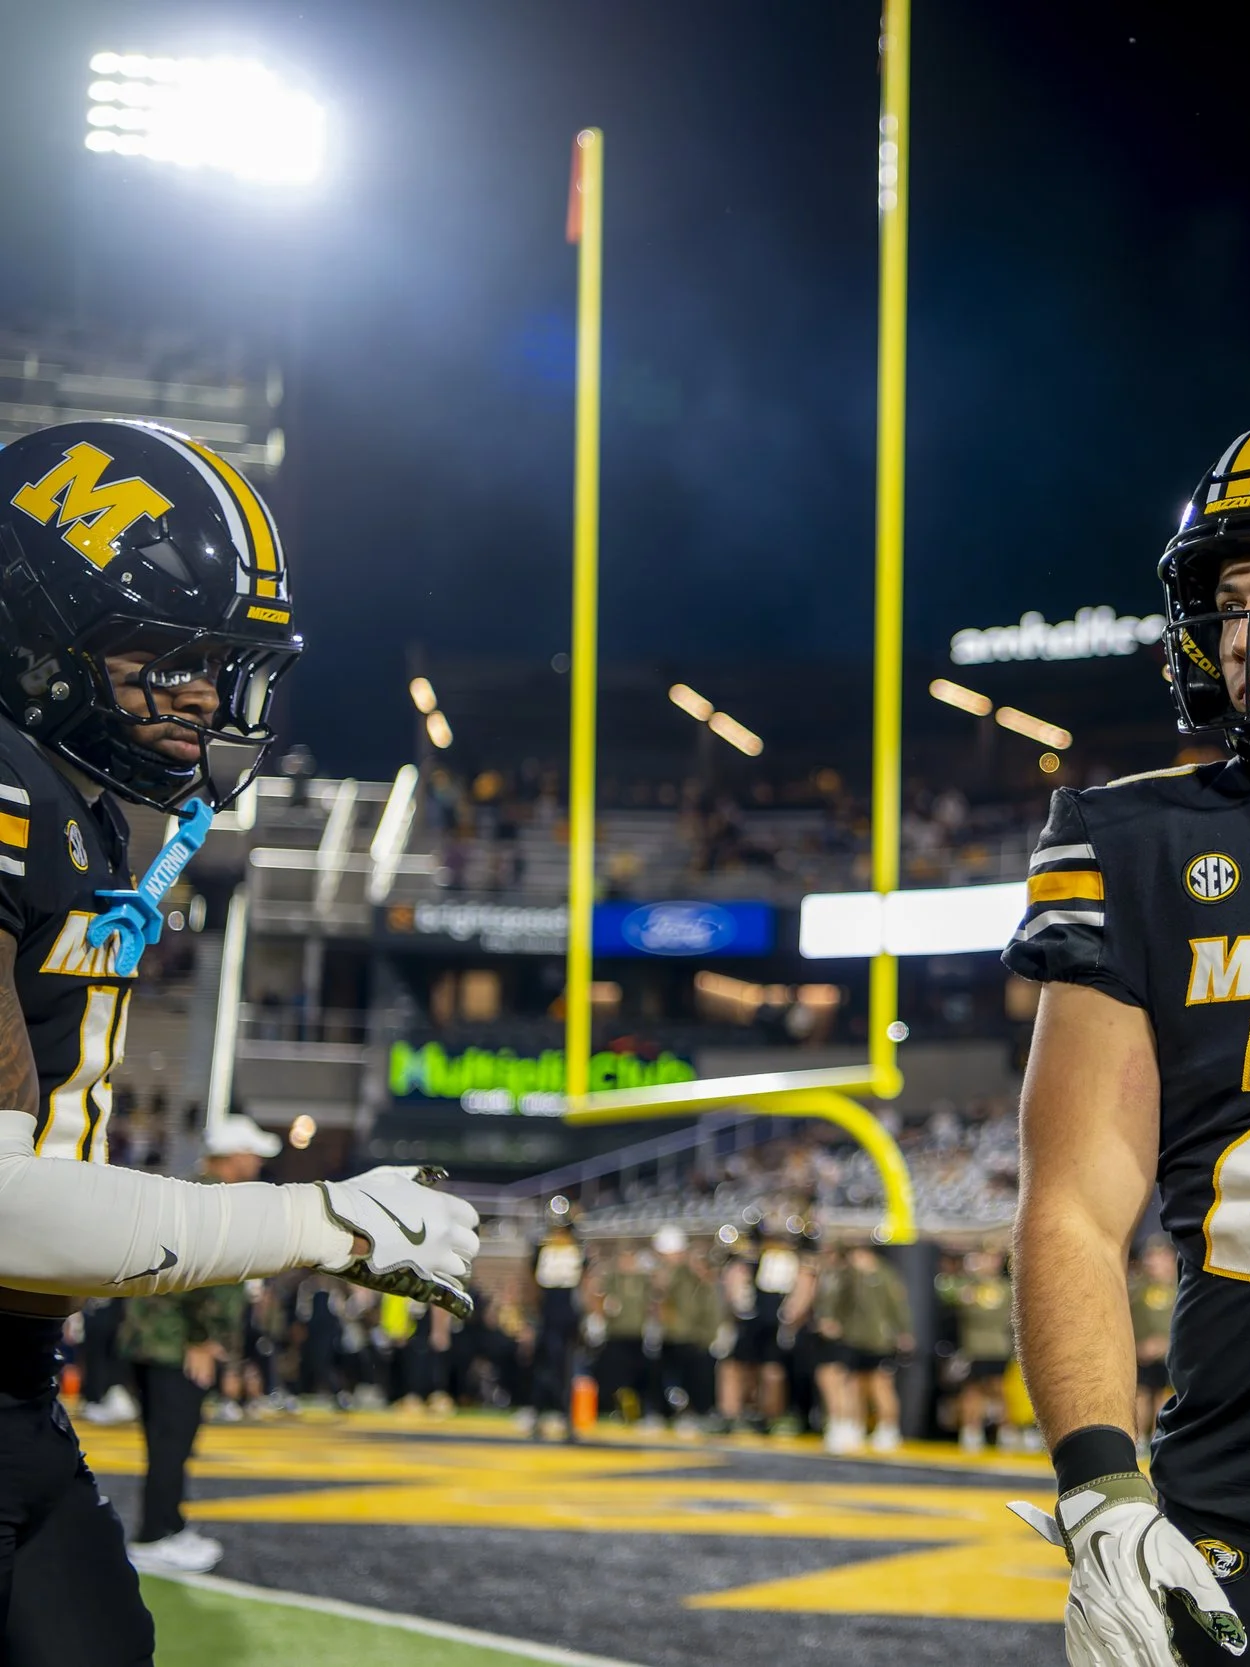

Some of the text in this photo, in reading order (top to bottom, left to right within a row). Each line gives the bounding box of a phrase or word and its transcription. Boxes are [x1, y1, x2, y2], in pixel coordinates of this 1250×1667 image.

[10, 441, 175, 571] M
[145, 841, 189, 900] NXTRND
[1190, 857, 1235, 898] SEC
